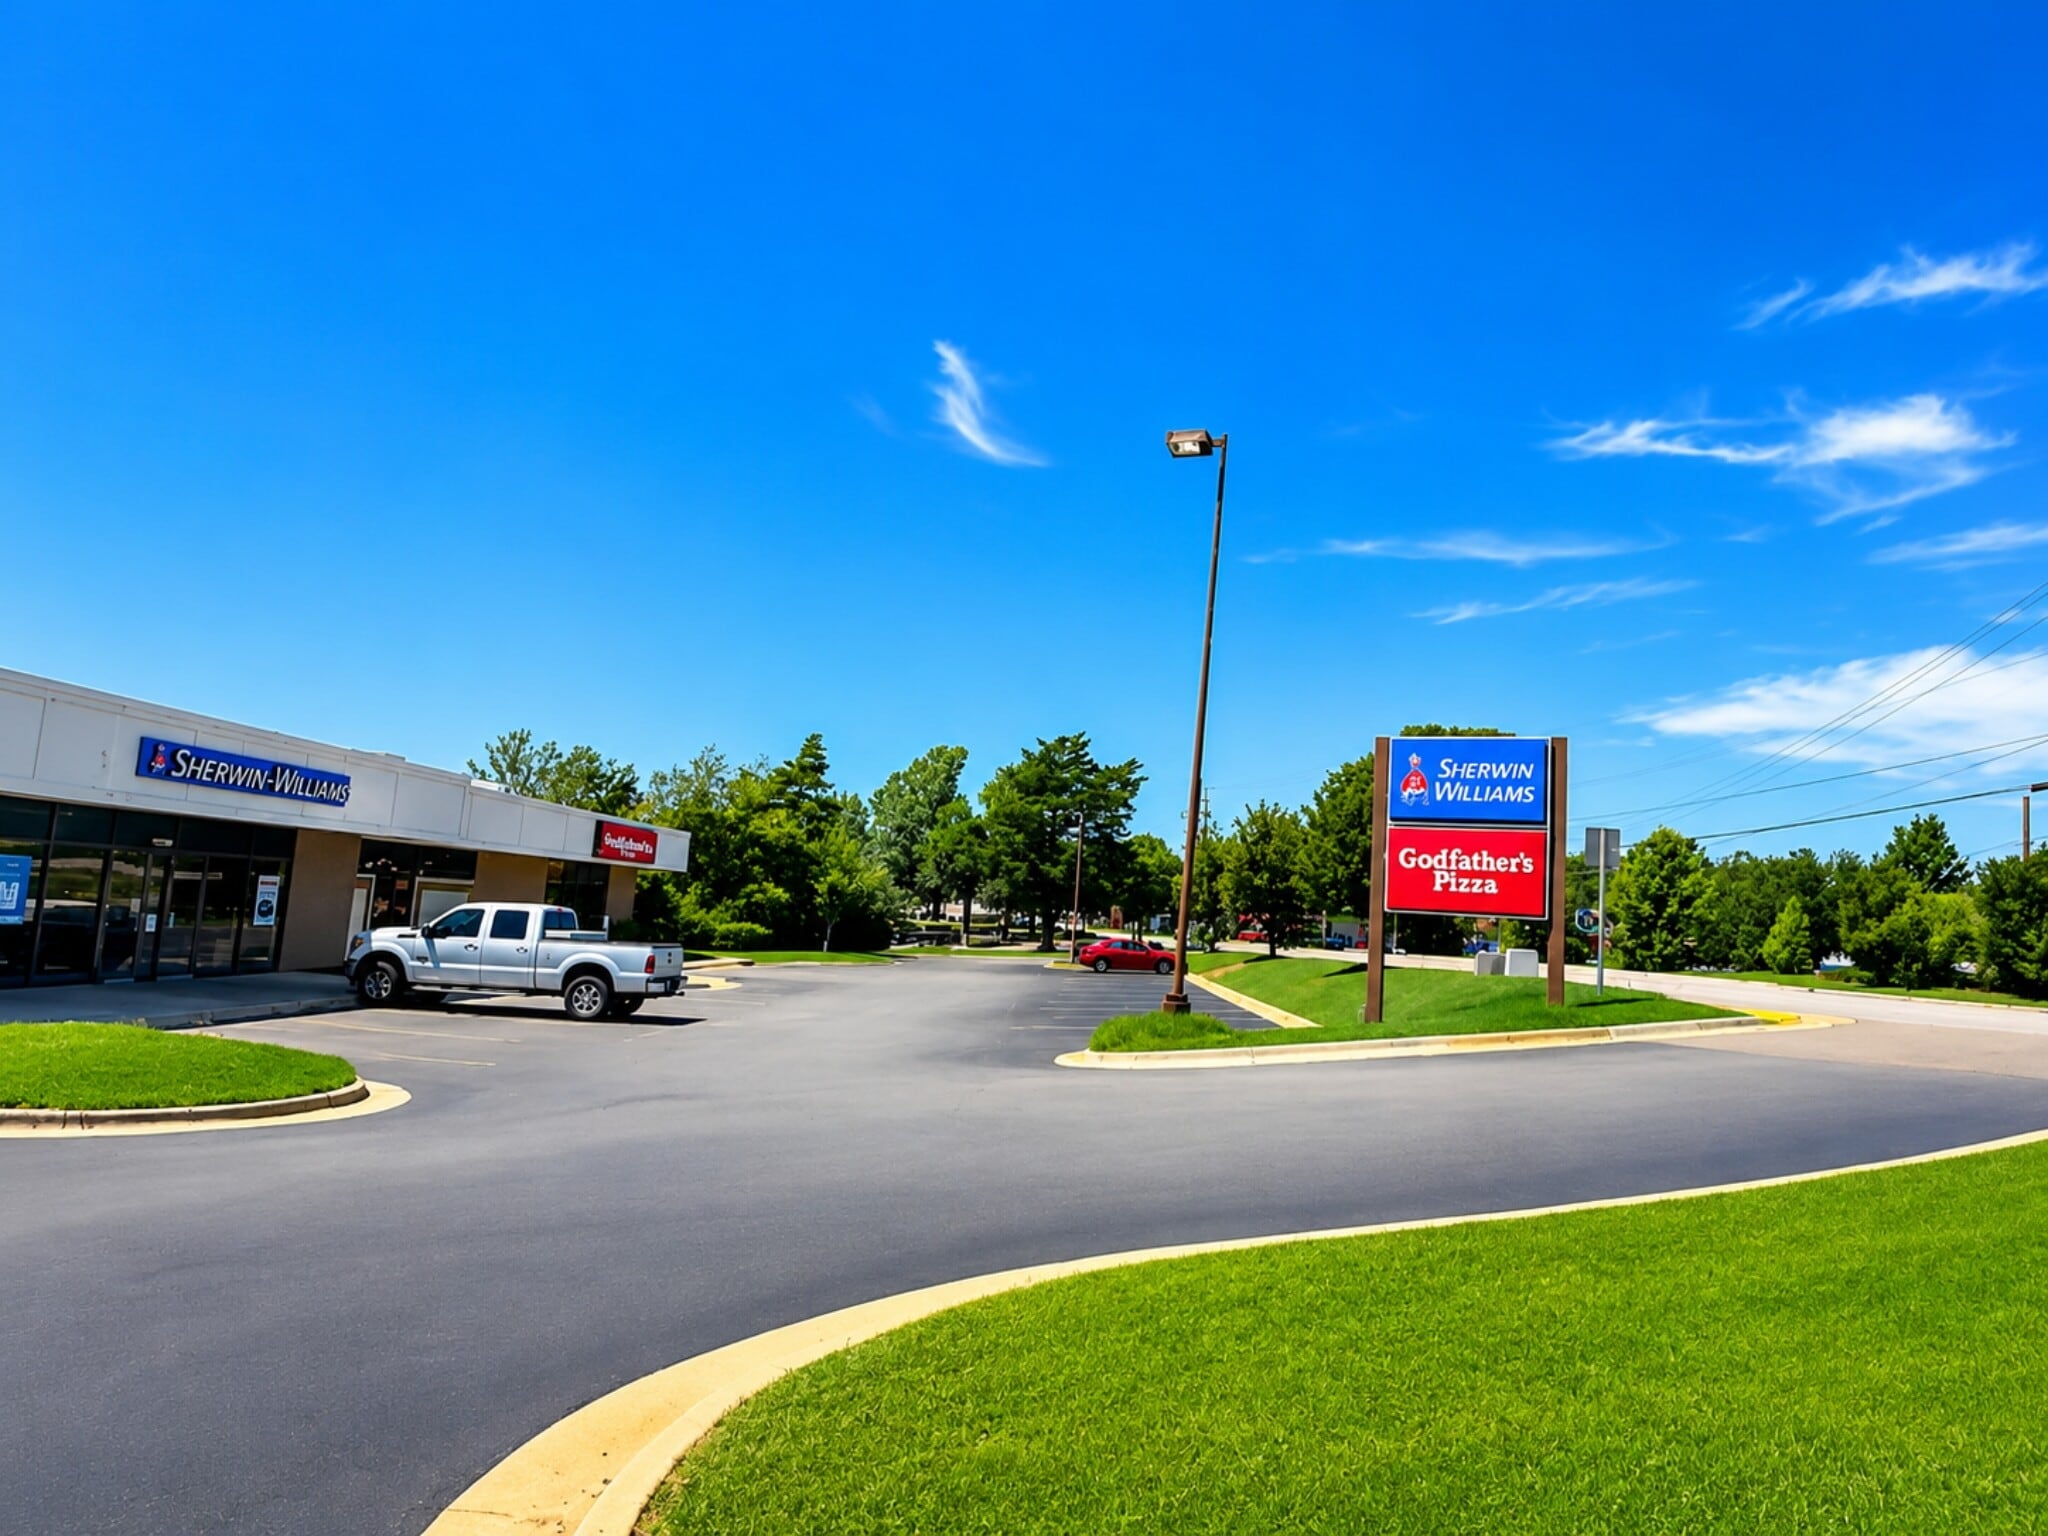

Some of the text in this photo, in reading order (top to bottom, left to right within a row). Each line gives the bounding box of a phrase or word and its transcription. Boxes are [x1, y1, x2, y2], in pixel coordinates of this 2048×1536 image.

[171, 748, 350, 803] SHERWIN-WILLIAMS
[1437, 758, 1535, 780] SHERWIN
[1434, 781, 1536, 803] WILLIAMS
[1398, 847, 1534, 873] Godfather's
[1432, 870, 1499, 894] Pizza
